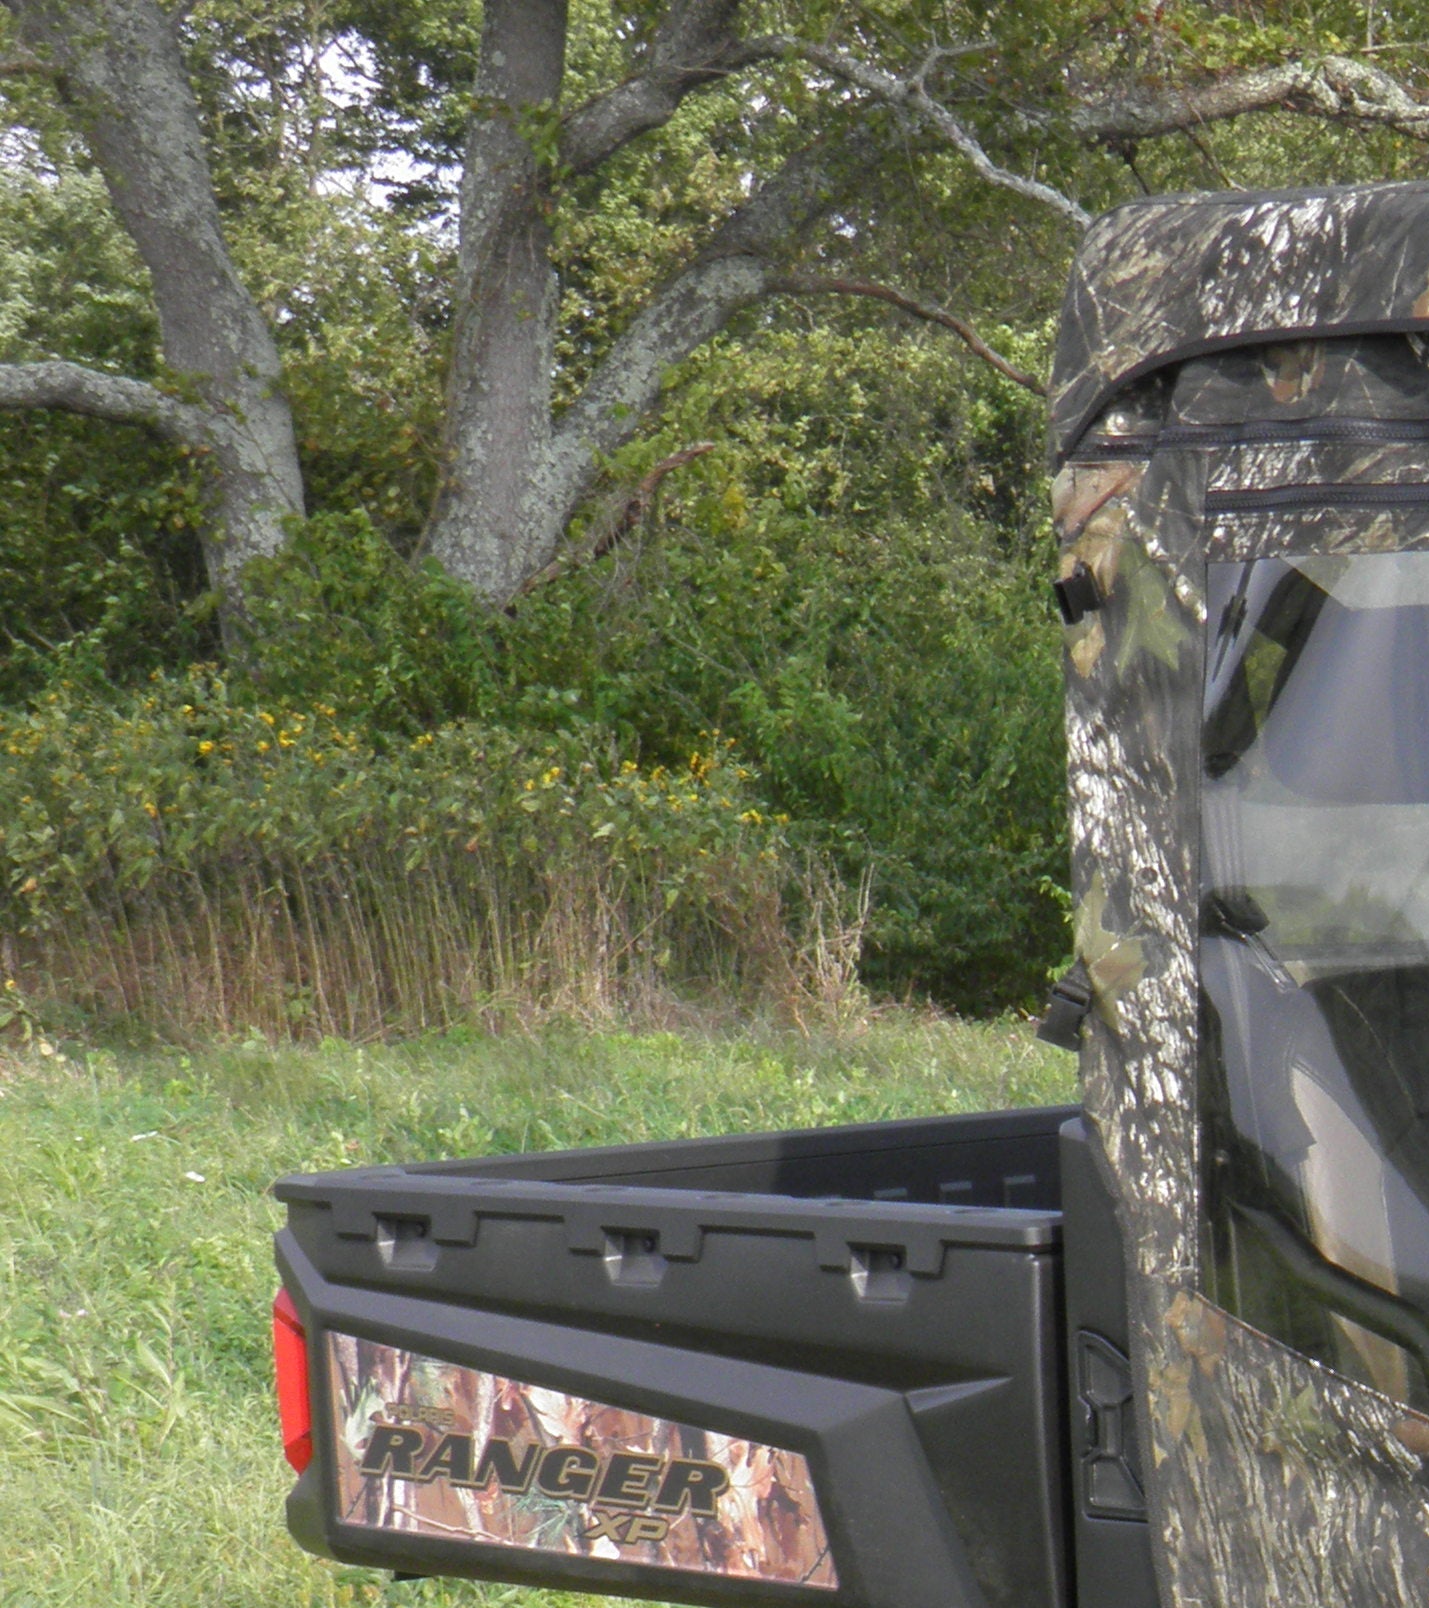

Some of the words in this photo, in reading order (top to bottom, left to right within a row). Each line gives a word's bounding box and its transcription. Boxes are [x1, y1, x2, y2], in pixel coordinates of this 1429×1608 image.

[385, 1402, 455, 1426] POLARIS
[360, 1423, 731, 1518] RANGER
[584, 1508, 670, 1545] XP
